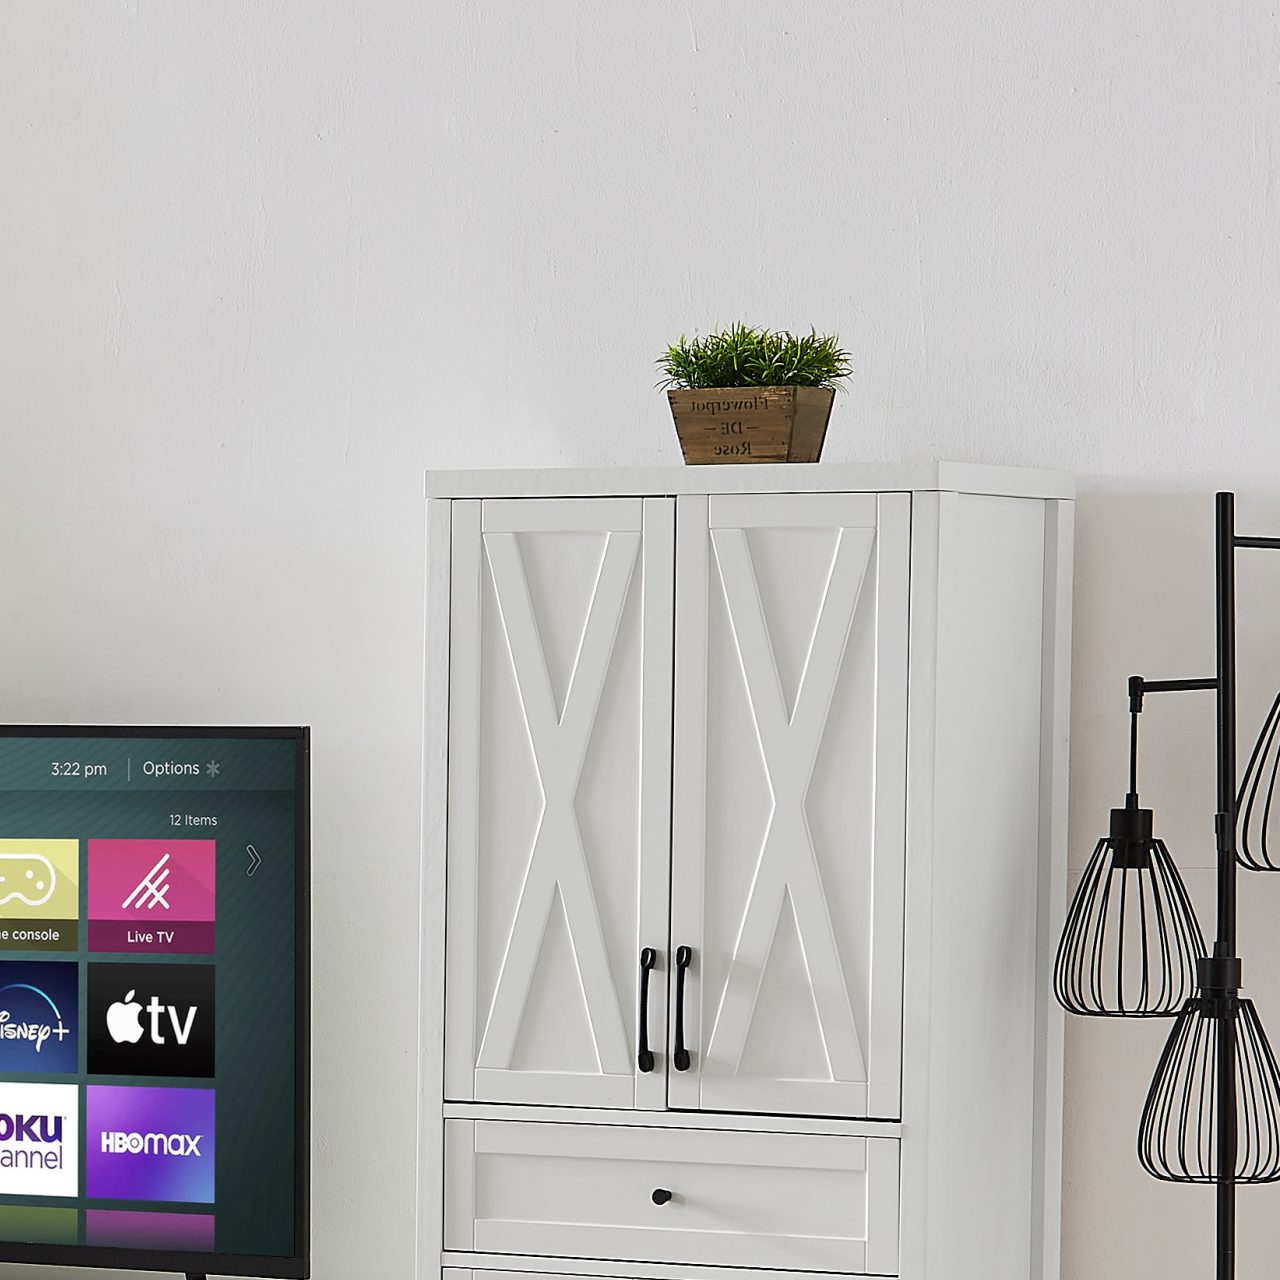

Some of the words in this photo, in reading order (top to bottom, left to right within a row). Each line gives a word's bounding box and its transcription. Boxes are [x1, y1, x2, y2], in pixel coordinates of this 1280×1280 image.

[51, 762, 80, 776] 3:22
[84, 764, 107, 778] pm
[143, 761, 200, 778] Options
[169, 814, 182, 826] 12
[184, 814, 218, 827] Items
[12, 928, 59, 941] console
[127, 930, 154, 943] Live
[155, 931, 174, 944] TV
[146, 996, 198, 1045] tv
